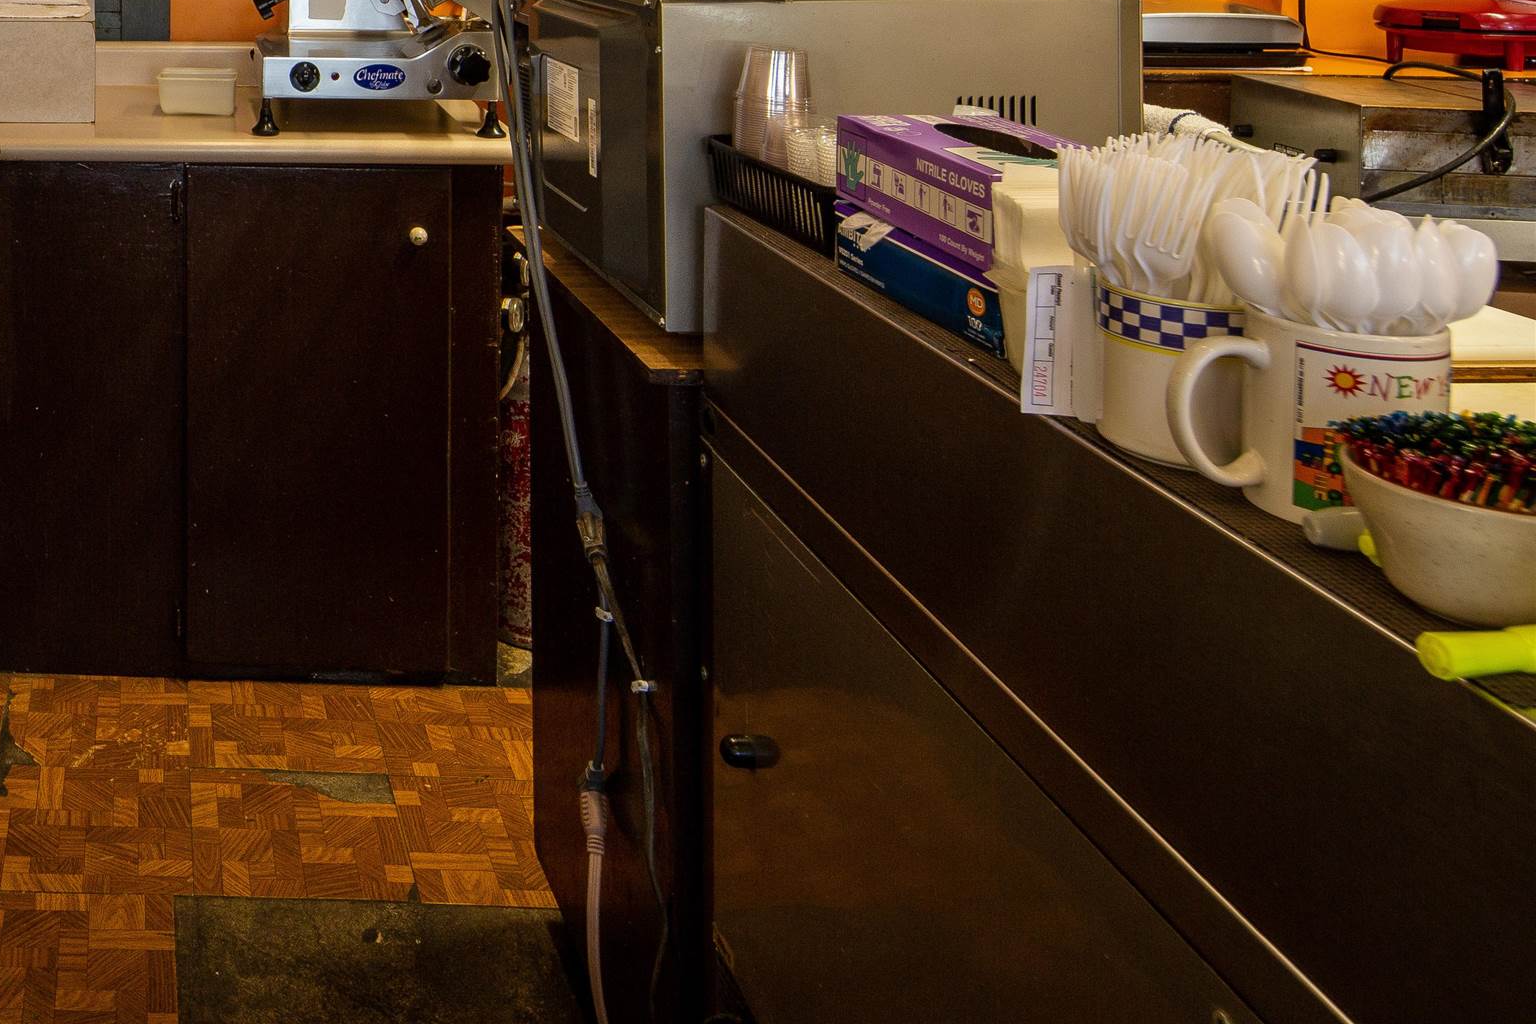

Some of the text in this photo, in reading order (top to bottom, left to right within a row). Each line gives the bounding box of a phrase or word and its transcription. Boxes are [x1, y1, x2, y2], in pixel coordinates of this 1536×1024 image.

[356, 69, 404, 83] Chefmate
[916, 158, 986, 199] NITRILE GLOVES
